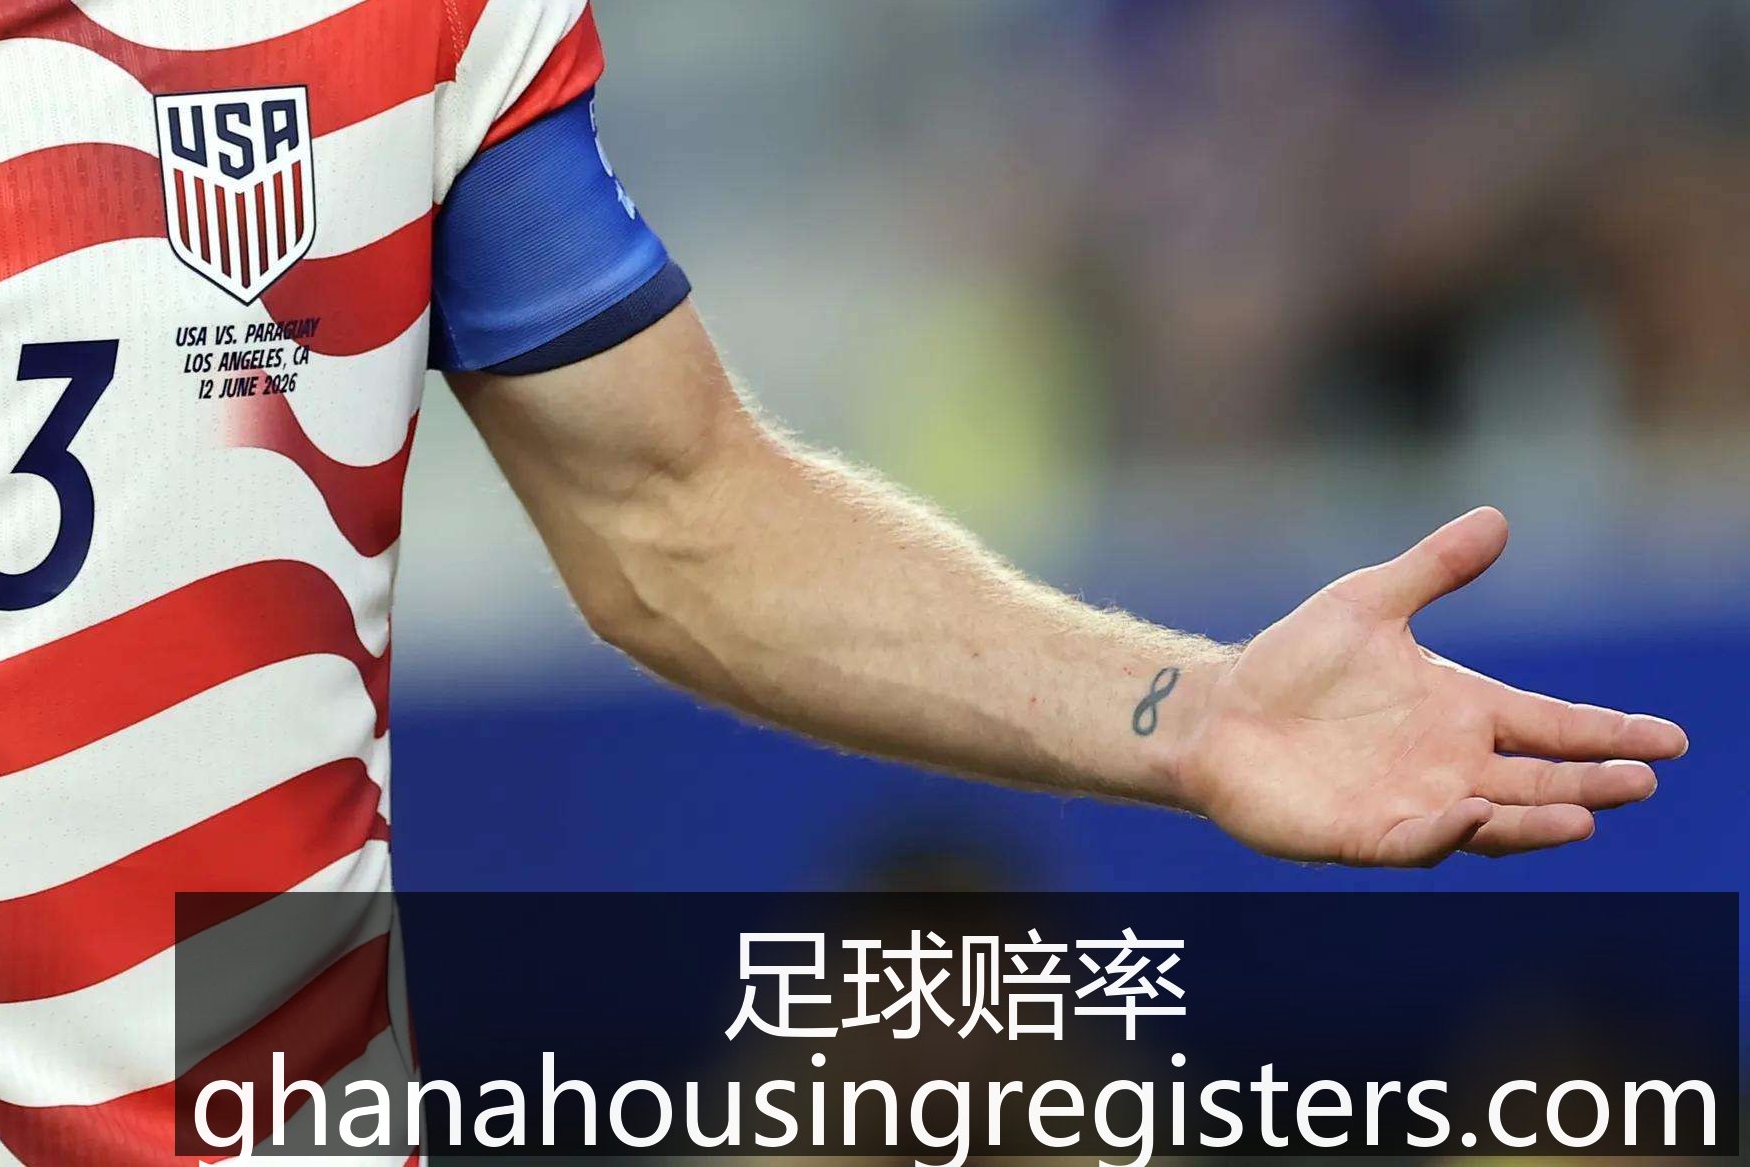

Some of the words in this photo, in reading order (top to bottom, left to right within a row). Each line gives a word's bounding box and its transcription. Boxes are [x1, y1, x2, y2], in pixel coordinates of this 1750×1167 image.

[168, 99, 300, 180] USA
[176, 326, 207, 346] USA
[215, 325, 237, 346] VS.
[245, 318, 320, 344] PARAGUAY
[184, 353, 213, 373] LOS
[218, 348, 287, 371] ANGELES,
[293, 345, 310, 365] CA
[198, 380, 213, 399] 12
[219, 377, 259, 398] JUNE
[263, 373, 298, 395] 2026
